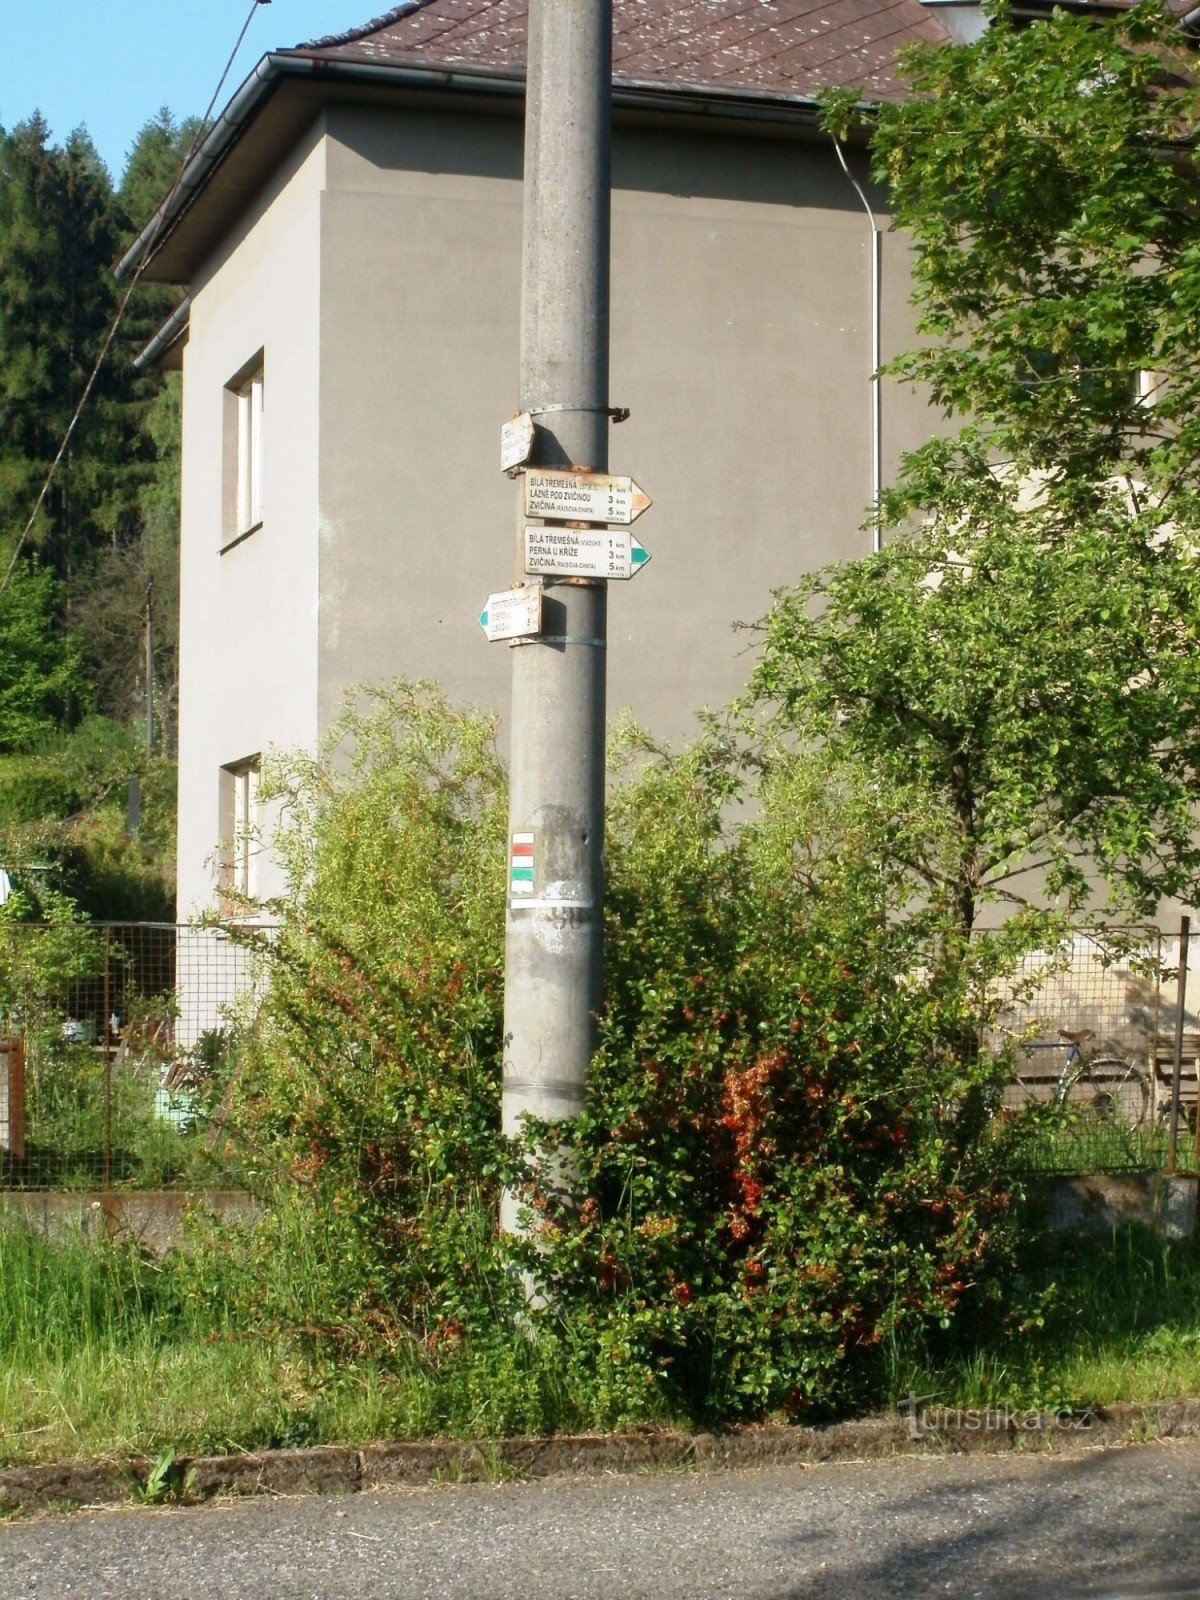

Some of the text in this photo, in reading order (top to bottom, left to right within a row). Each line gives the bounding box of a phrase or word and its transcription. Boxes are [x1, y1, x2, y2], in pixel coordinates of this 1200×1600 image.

[608, 484, 613, 492] 1
[550, 491, 563, 500] POD
[563, 491, 591, 502] ZVIČINOU
[608, 496, 613, 504] 3
[529, 500, 555, 510] ZVIČINA
[608, 507, 614, 515] 5
[529, 532, 544, 543] BÍLÁ
[545, 534, 579, 546] TŘEMEŠNÁ
[608, 539, 613, 547] 1
[529, 545, 551, 555] PERNÁ
[552, 548, 558, 556] U
[558, 546, 578, 557] KŘÍŽE
[608, 551, 614, 559] 3
[529, 556, 555, 567] ZVIČINA
[609, 562, 615, 571] 5
